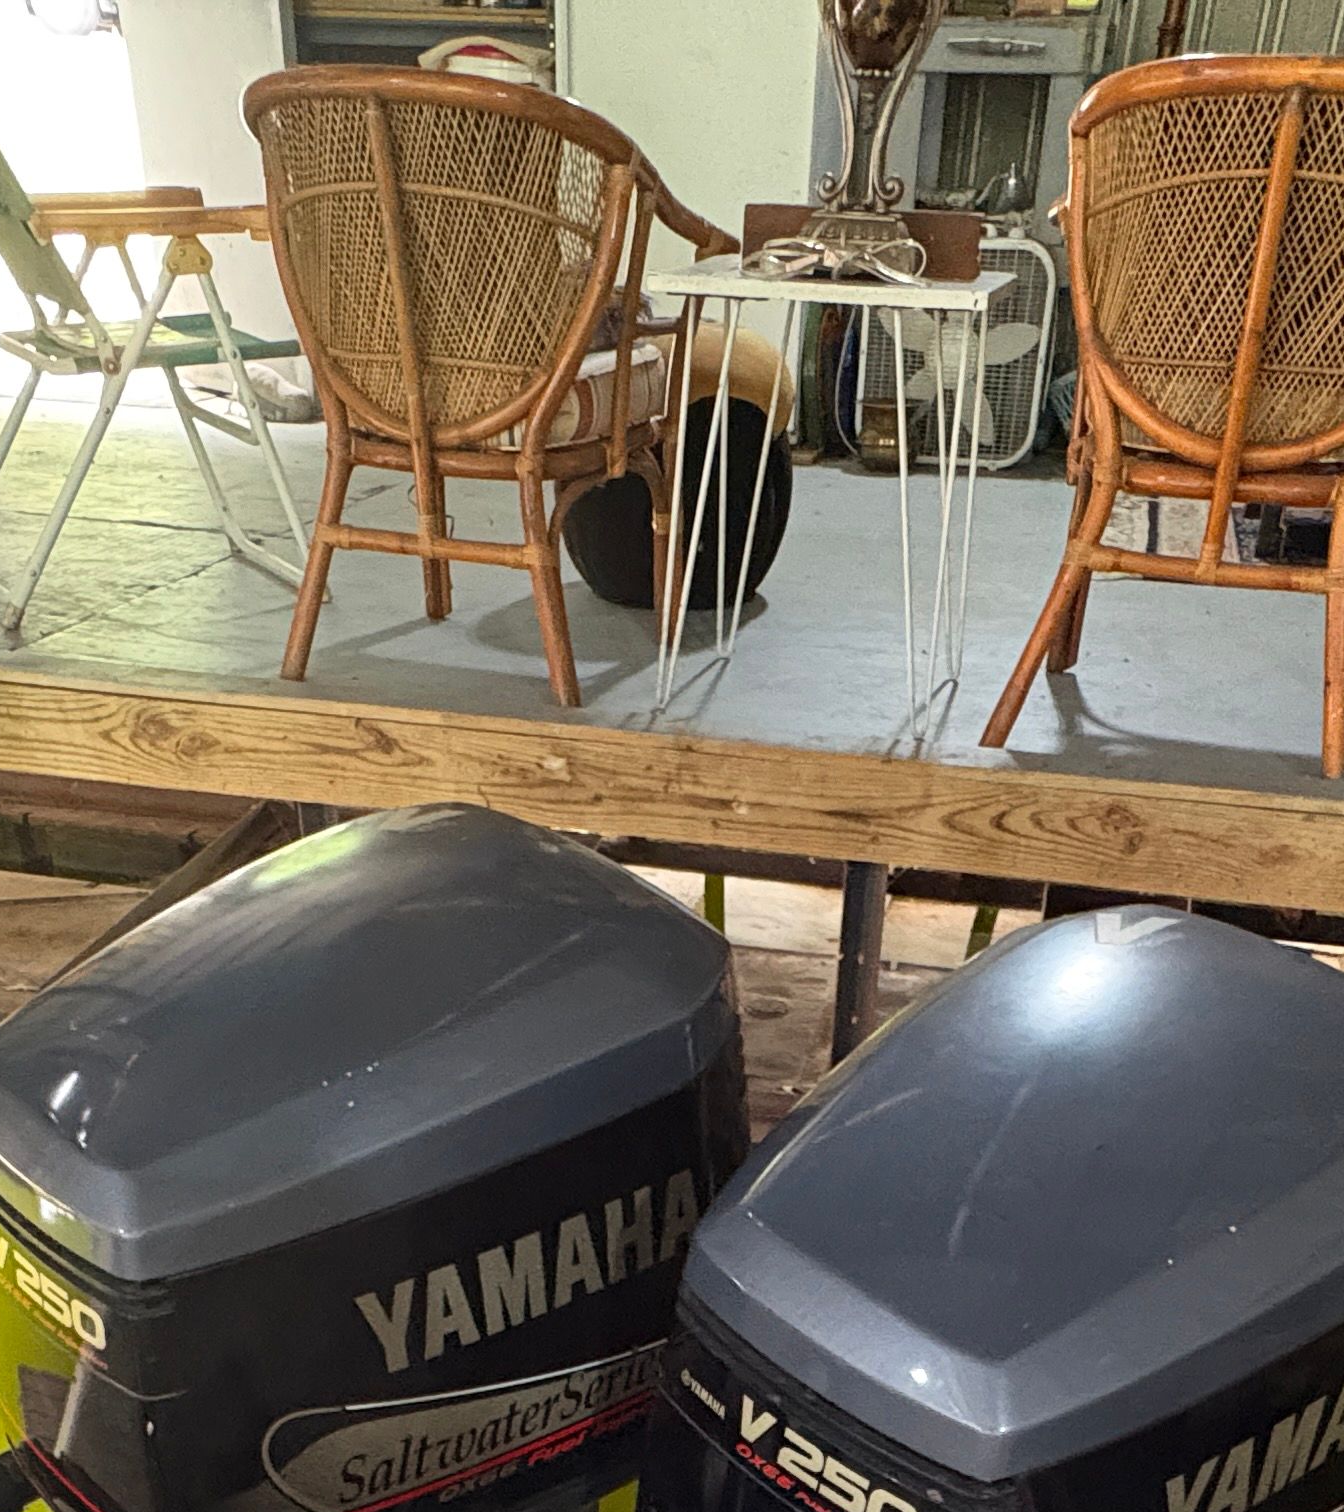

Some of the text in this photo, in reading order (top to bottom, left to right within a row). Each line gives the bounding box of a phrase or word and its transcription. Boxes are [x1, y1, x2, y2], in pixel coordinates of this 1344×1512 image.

[13, 1249, 107, 1350] 250
[354, 1168, 702, 1375] YAMAHA
[689, 1377, 727, 1421] YAMAHA
[740, 1394, 778, 1444] V
